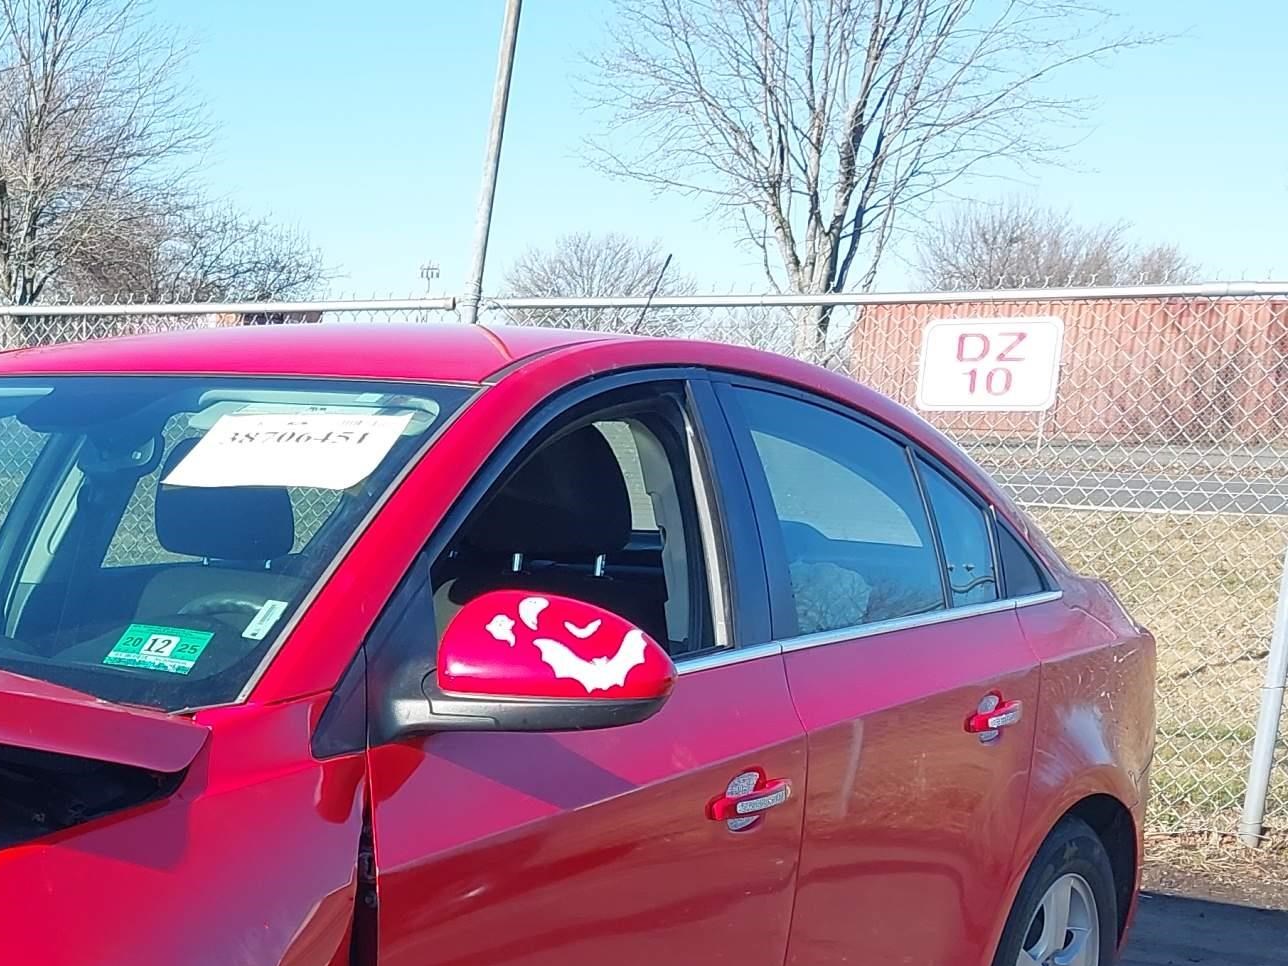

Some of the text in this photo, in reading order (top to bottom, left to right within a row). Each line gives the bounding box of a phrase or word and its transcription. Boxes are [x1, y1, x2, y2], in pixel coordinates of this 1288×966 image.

[956, 332, 1028, 362] DZ
[962, 367, 1013, 396] 10
[122, 636, 201, 655] 20 12 25
